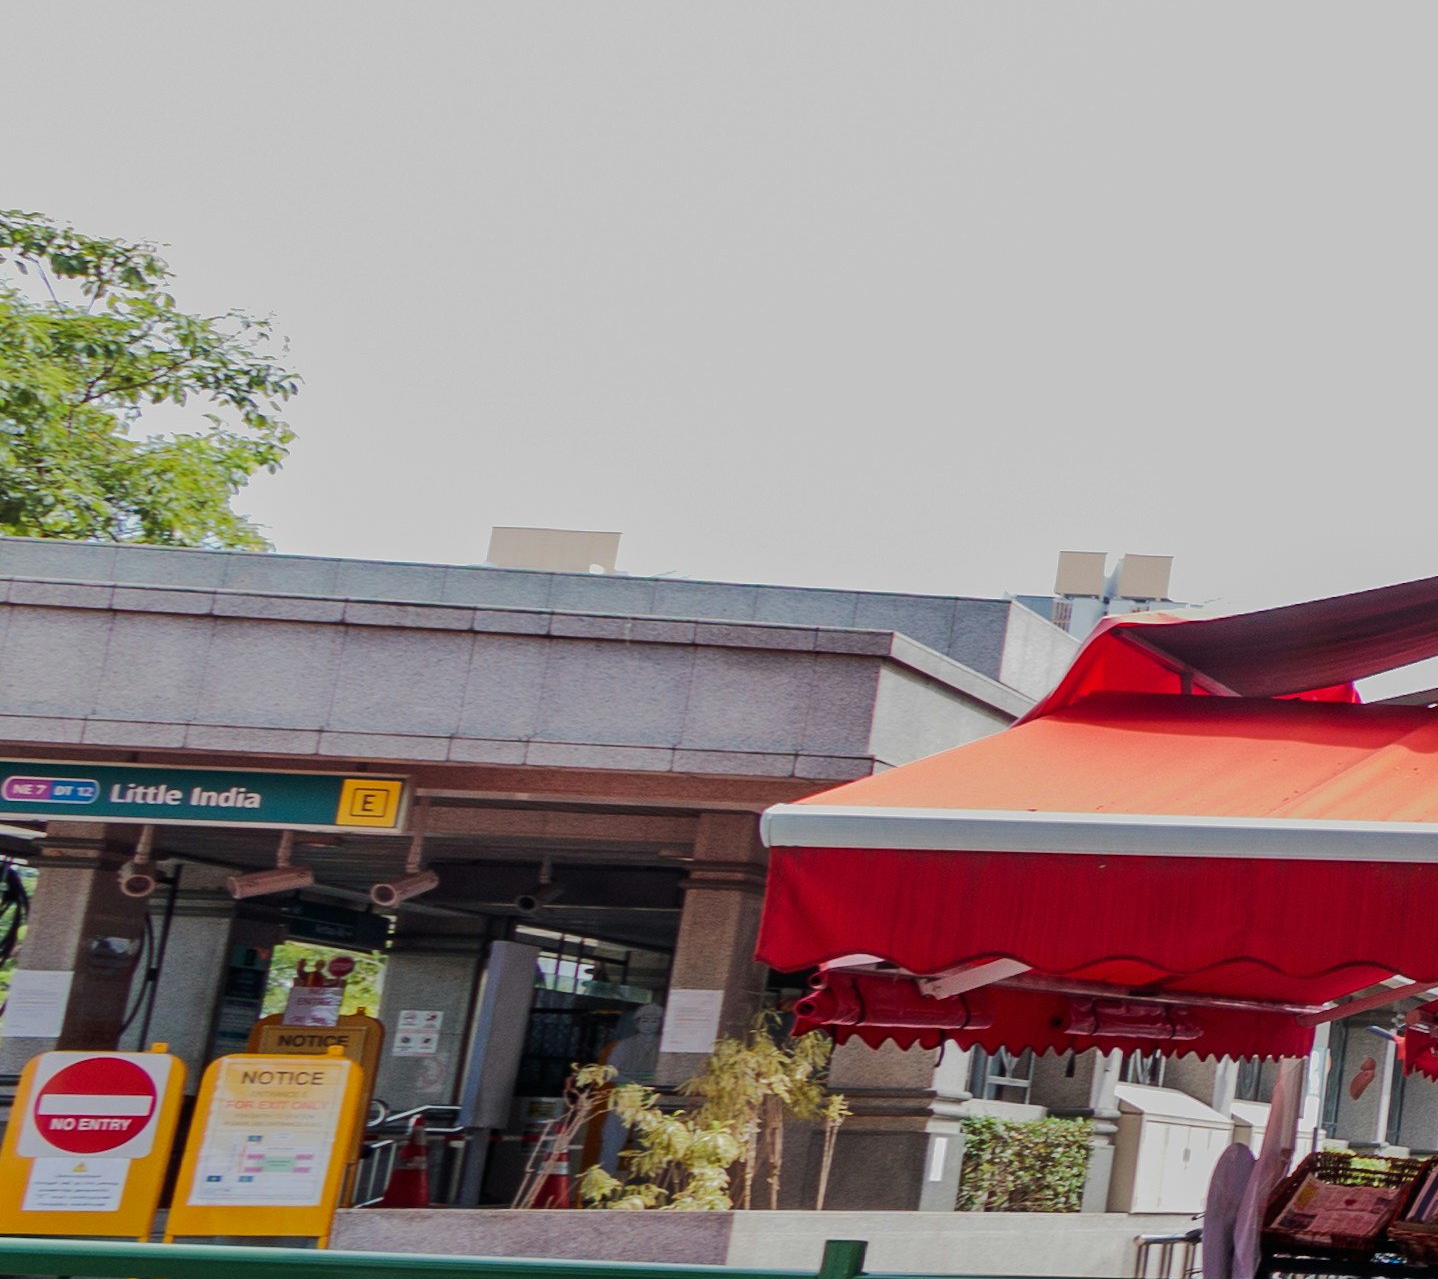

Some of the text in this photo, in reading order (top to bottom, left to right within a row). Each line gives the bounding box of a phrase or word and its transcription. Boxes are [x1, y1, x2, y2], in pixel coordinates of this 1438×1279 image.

[110, 784, 183, 805] Little
[189, 787, 262, 809] India
[361, 794, 376, 812] E
[278, 1034, 349, 1048] NOTICE
[241, 1070, 325, 1086] NOTICE
[48, 1118, 133, 1131] NO ENTRY
